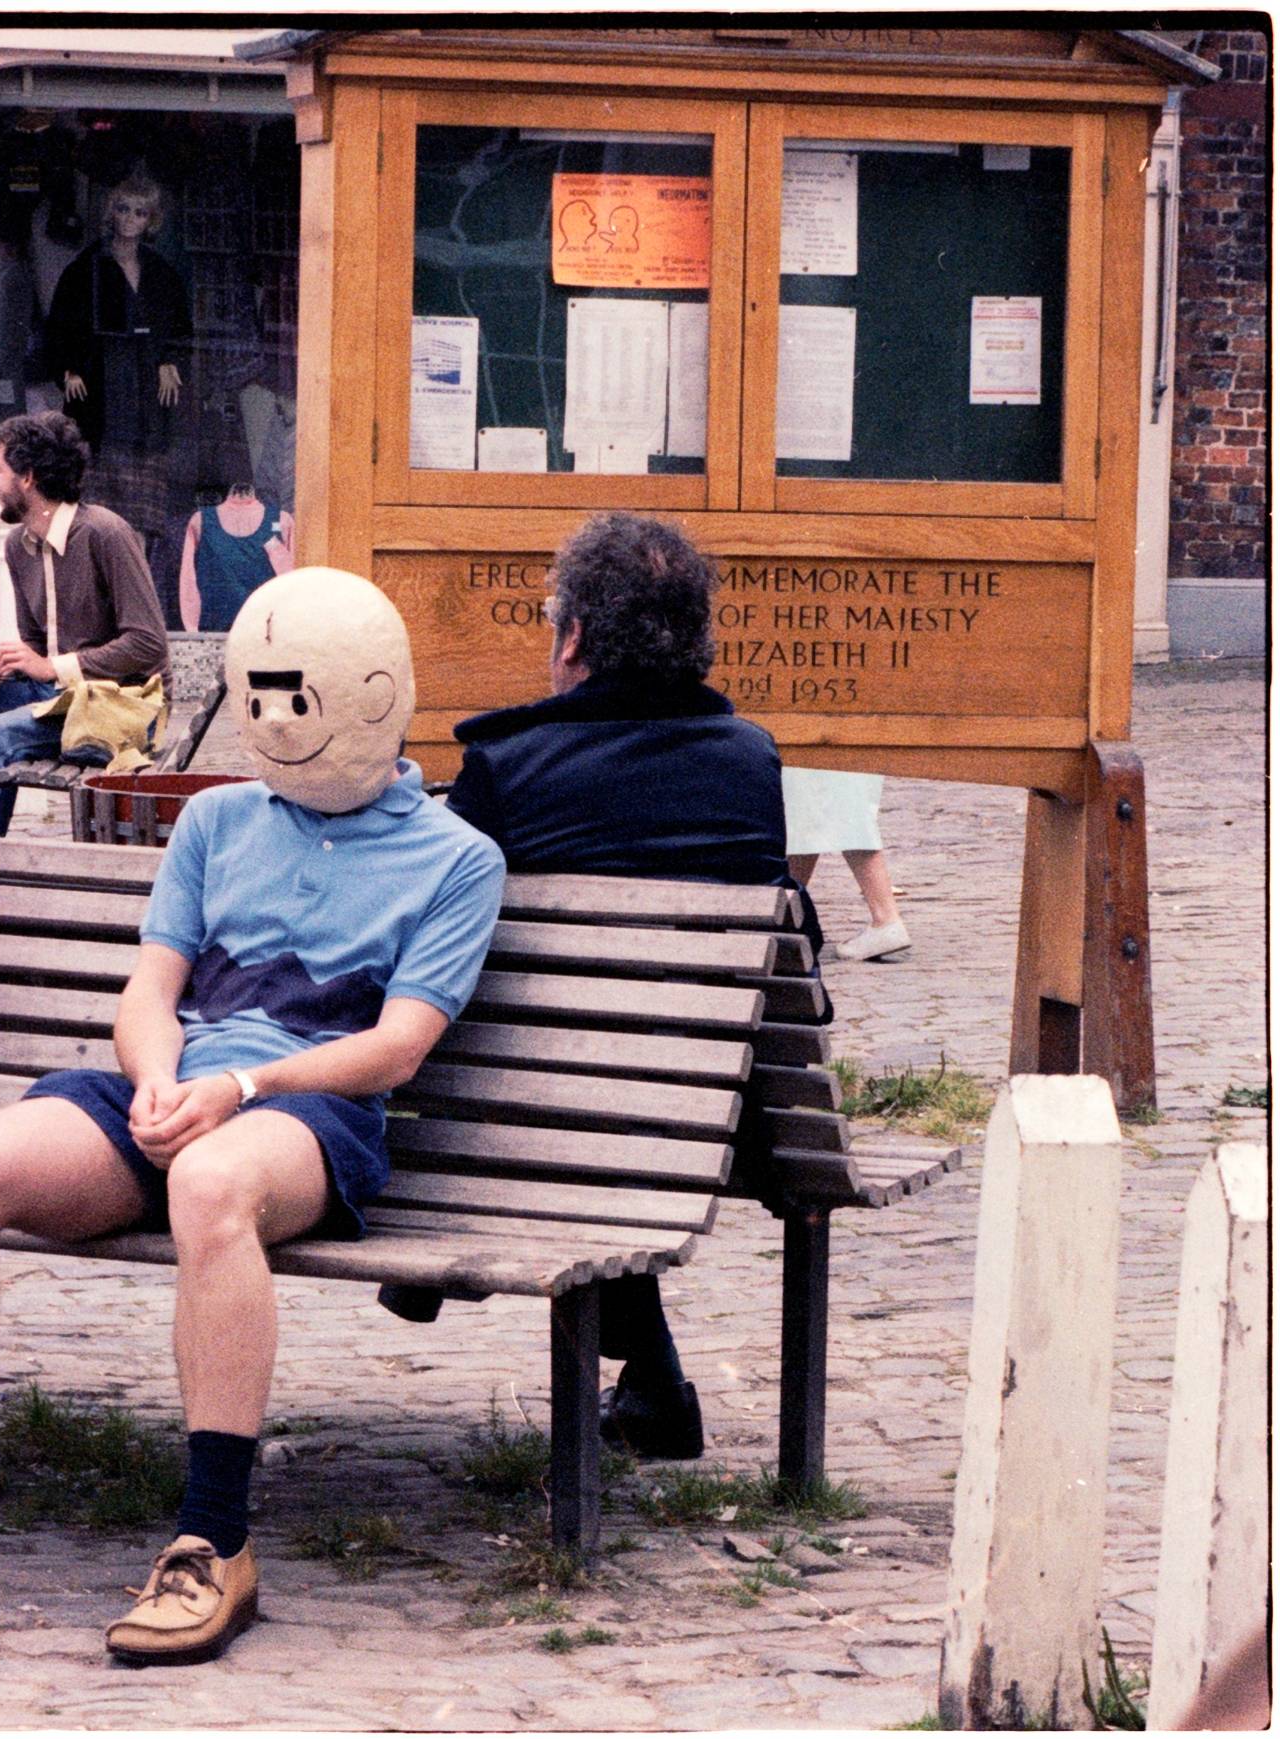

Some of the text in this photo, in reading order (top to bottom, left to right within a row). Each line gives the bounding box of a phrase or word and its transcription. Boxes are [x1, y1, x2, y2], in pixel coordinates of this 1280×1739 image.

[939, 570, 1000, 597] THE
[718, 603, 757, 629] OF
[774, 604, 830, 630] HER
[845, 605, 980, 634] MAJESTY
[715, 640, 909, 668] LIZABETH II
[792, 678, 858, 704] 1953
